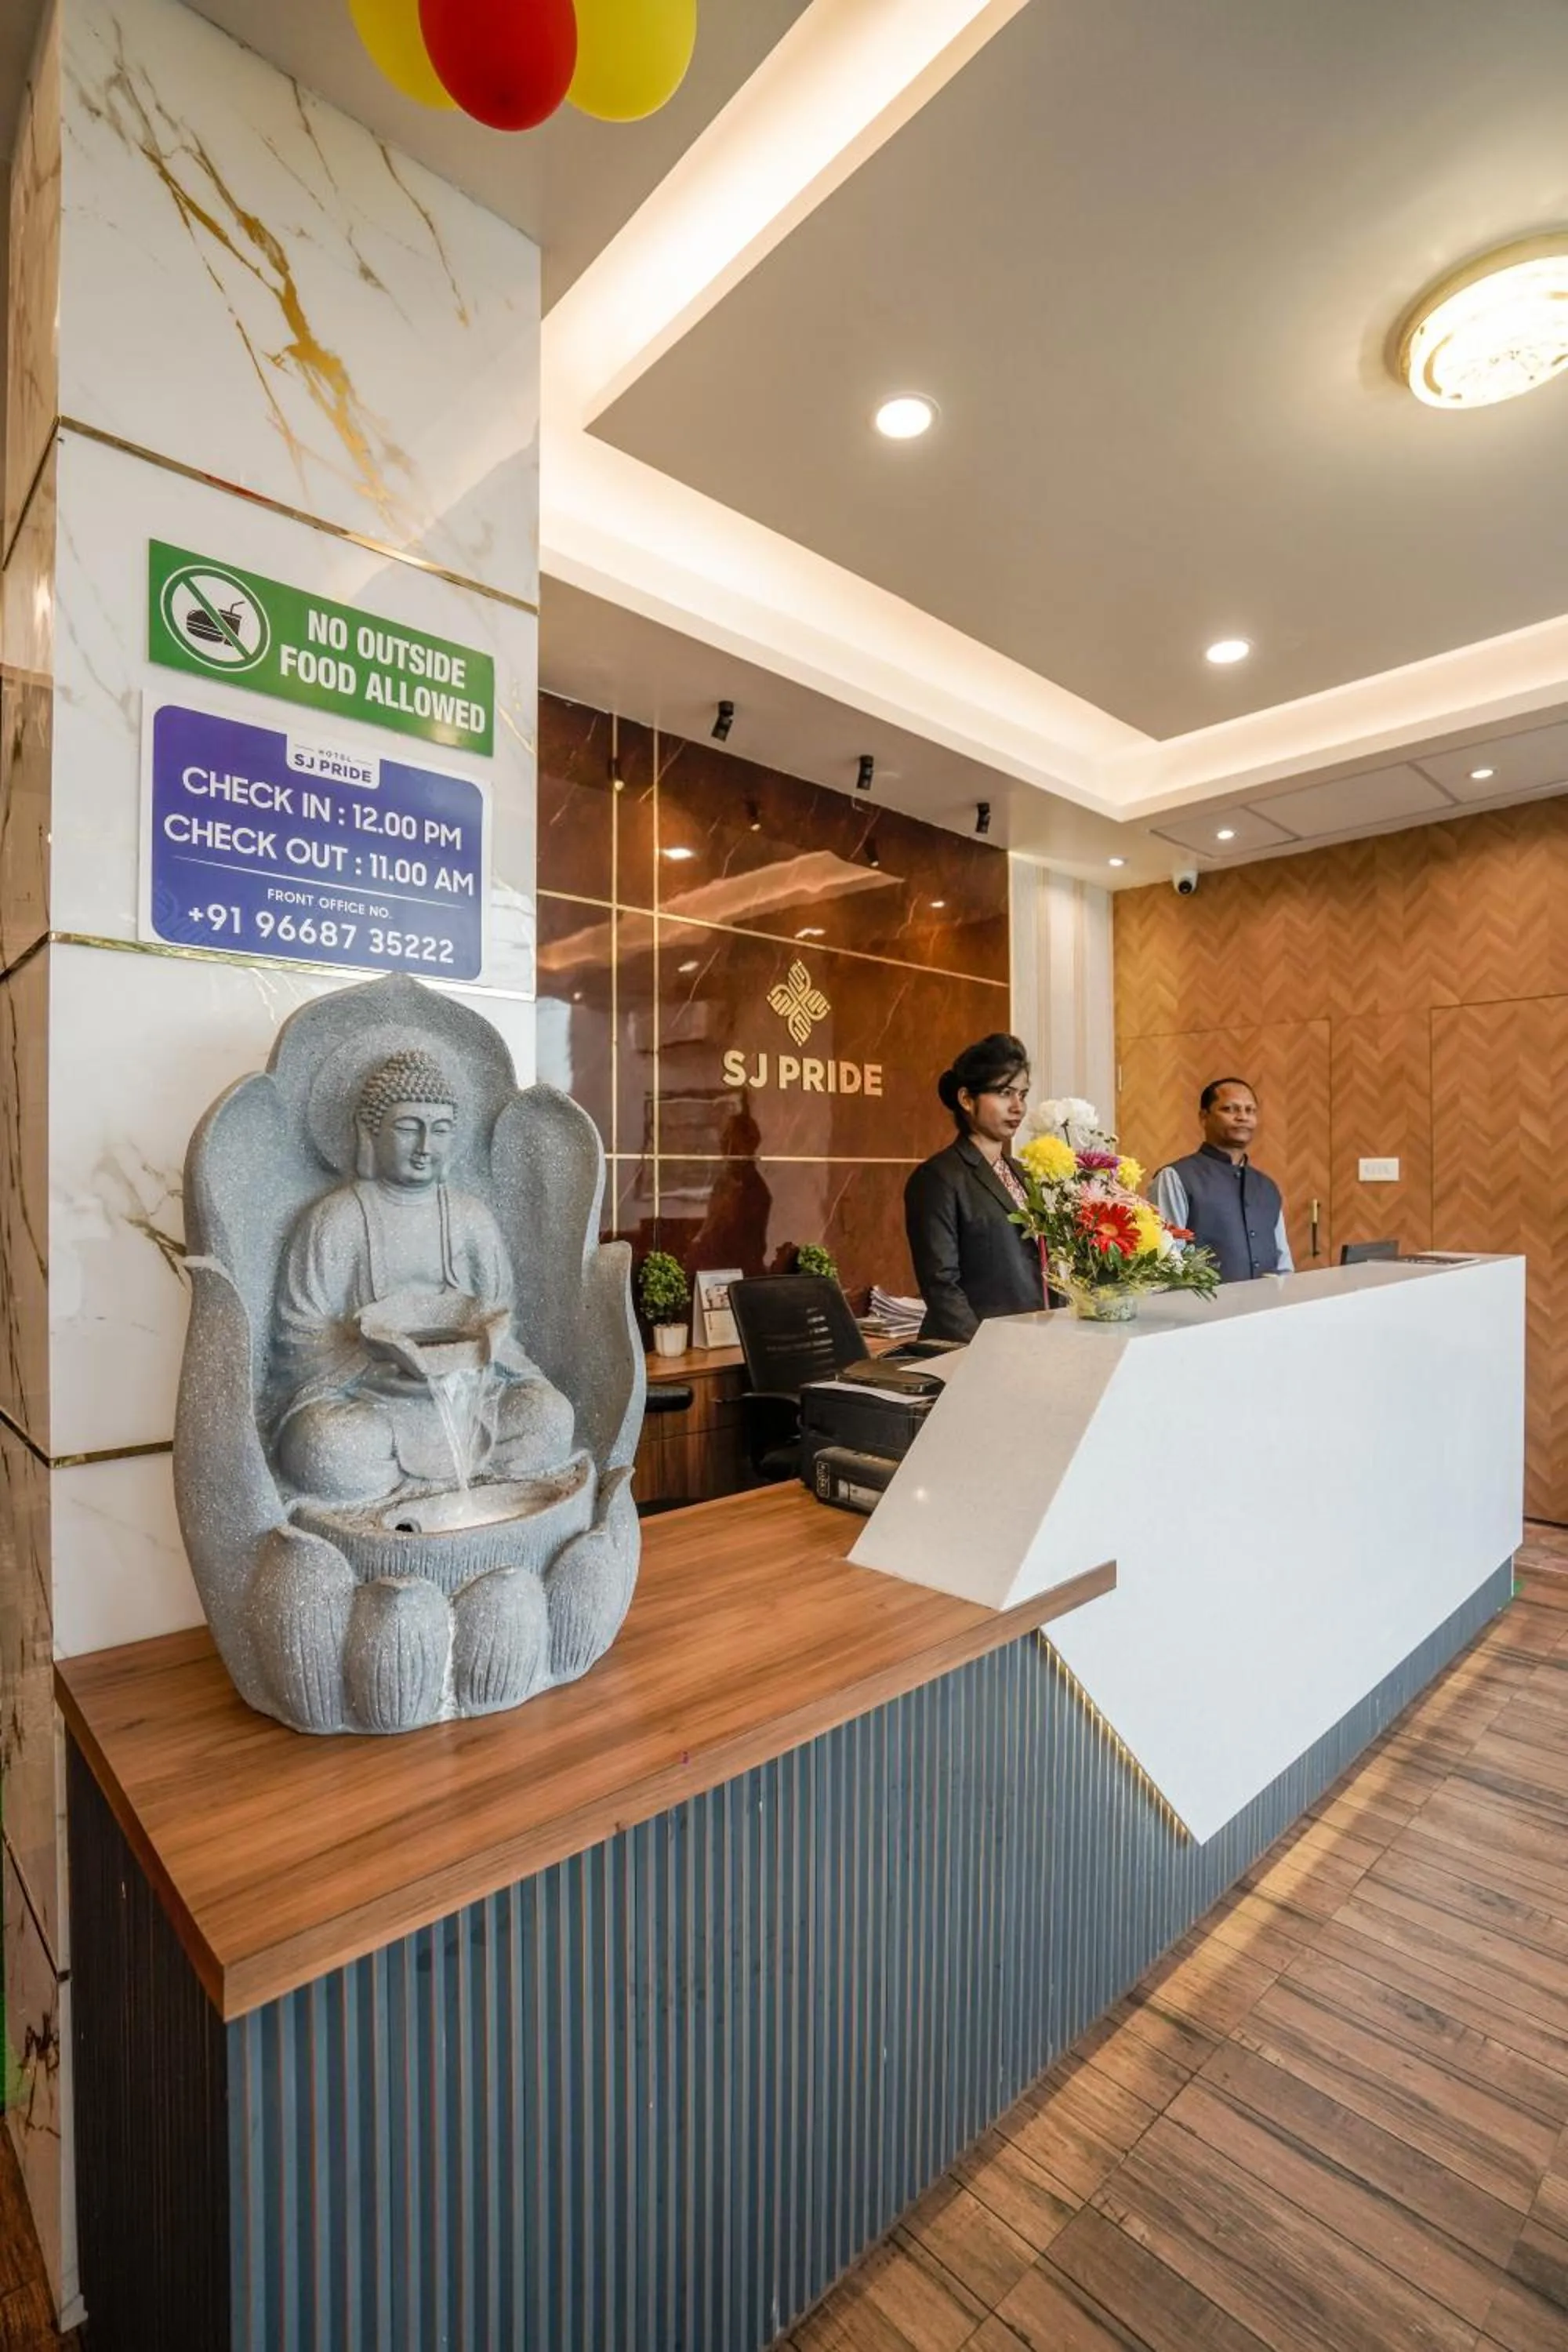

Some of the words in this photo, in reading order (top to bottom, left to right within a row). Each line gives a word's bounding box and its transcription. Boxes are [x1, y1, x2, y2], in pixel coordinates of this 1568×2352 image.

[308, 610, 347, 650] NO
[358, 626, 465, 688] OUTSIDE
[280, 644, 357, 695] FOOD
[365, 673, 486, 734] ALLOWED
[294, 753, 315, 769] SJ
[319, 760, 372, 782] PRIDE
[318, 750, 351, 762] HOTEL
[182, 766, 294, 815] CHECK
[303, 793, 330, 822] IN
[353, 804, 417, 840] 12.00
[424, 819, 462, 851] PM
[164, 813, 278, 860] CHECK
[285, 837, 348, 872] OUT
[369, 852, 427, 887] 11.00
[434, 867, 474, 896] AM
[267, 888, 314, 906] FRONT
[319, 898, 365, 915] OFFICE
[369, 906, 392, 919] NO.
[188, 904, 241, 934] +91
[256, 910, 357, 949] 96687
[369, 927, 454, 964] 35222
[723, 1050, 768, 1088] SJ
[779, 1054, 883, 1096] PRIDE
